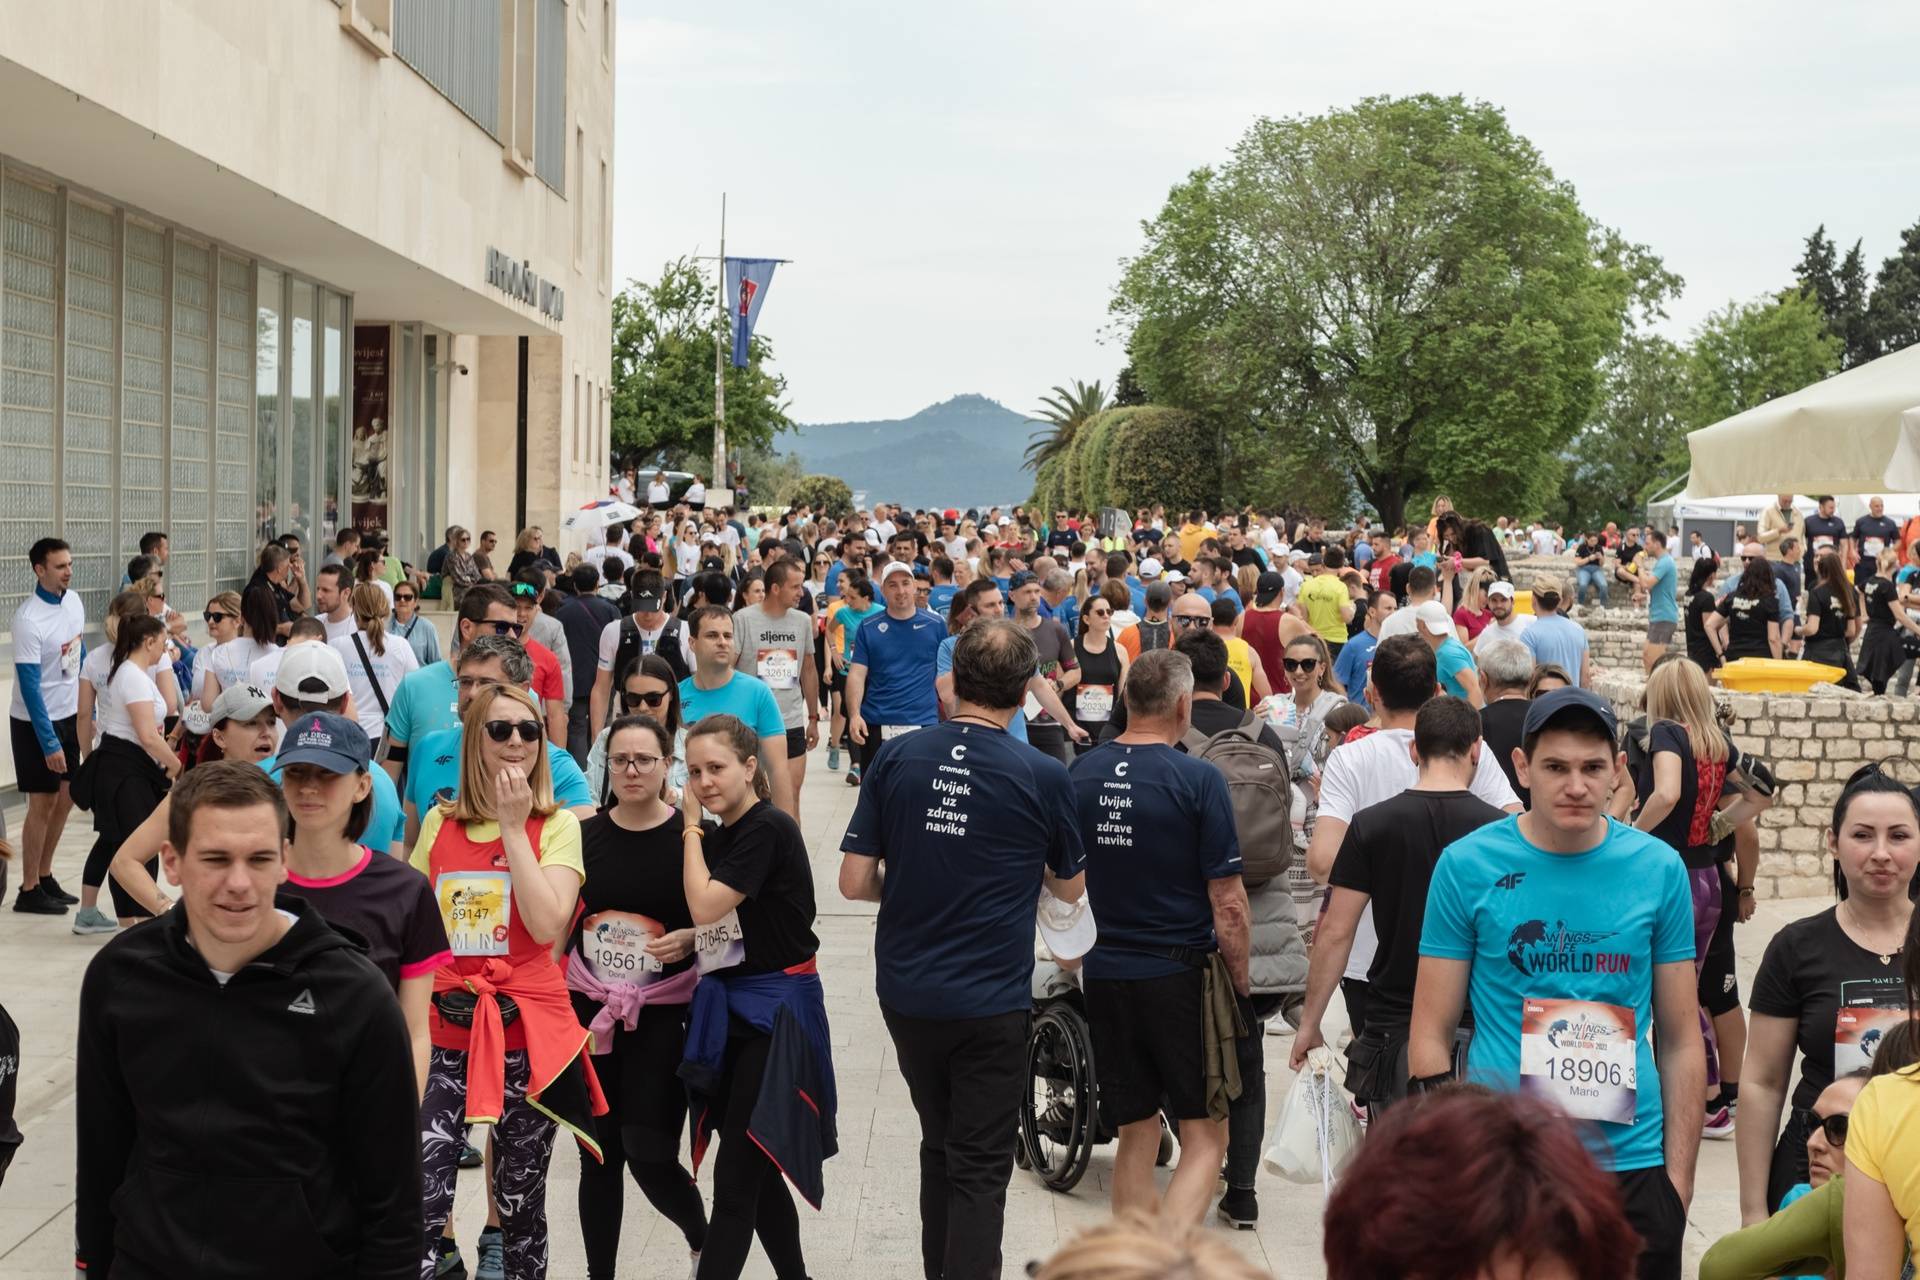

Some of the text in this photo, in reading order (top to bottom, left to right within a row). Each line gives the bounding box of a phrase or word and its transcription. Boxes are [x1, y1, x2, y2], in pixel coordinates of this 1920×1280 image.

[760, 630, 796, 644] sljeme
[310, 731, 332, 740] DECK
[435, 755, 454, 766] 4F
[939, 764, 971, 776] cromaris
[932, 778, 972, 796] Uvijek
[1103, 781, 1132, 790] cromaris
[942, 797, 958, 807] uz
[1099, 795, 1133, 809] Uvijek
[926, 807, 968, 822] zdrave
[1108, 811, 1122, 820] uz
[925, 821, 966, 836] navike
[1096, 821, 1133, 834] zdrave
[1097, 834, 1133, 847] navike
[1494, 872, 1527, 890] 4F
[453, 908, 489, 920] 69147
[697, 924, 740, 952] 27645 4
[1545, 932, 1592, 944] WINGS
[1552, 942, 1577, 953] LIFE
[594, 949, 645, 972] 19561
[1528, 952, 1631, 974] WORLD RUN
[608, 970, 626, 979] Dora
[1571, 1022, 1608, 1035] WINGS
[1575, 1031, 1597, 1041] LIFE
[1545, 1056, 1636, 1087] 18906 3
[1569, 1085, 1600, 1098] Mario
